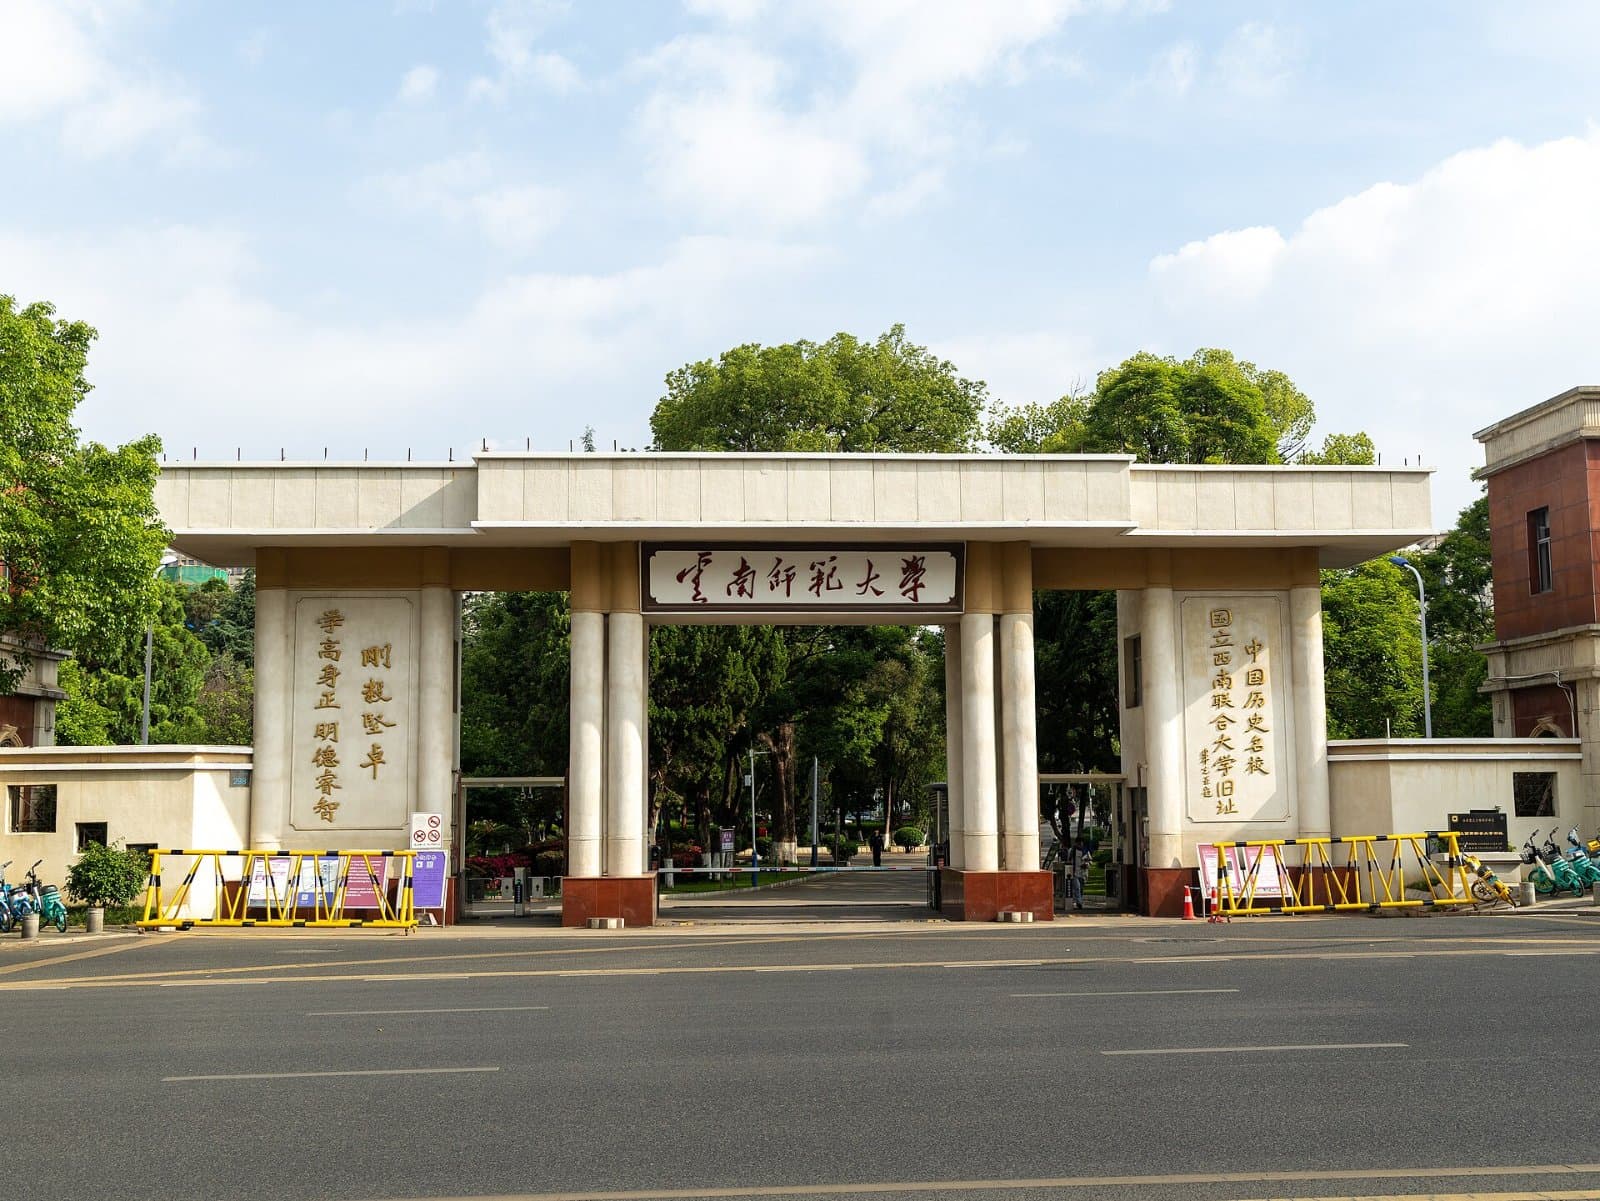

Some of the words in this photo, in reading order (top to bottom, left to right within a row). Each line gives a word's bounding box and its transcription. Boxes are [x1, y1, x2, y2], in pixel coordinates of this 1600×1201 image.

[1243, 638, 1270, 776] 中国历史名校
